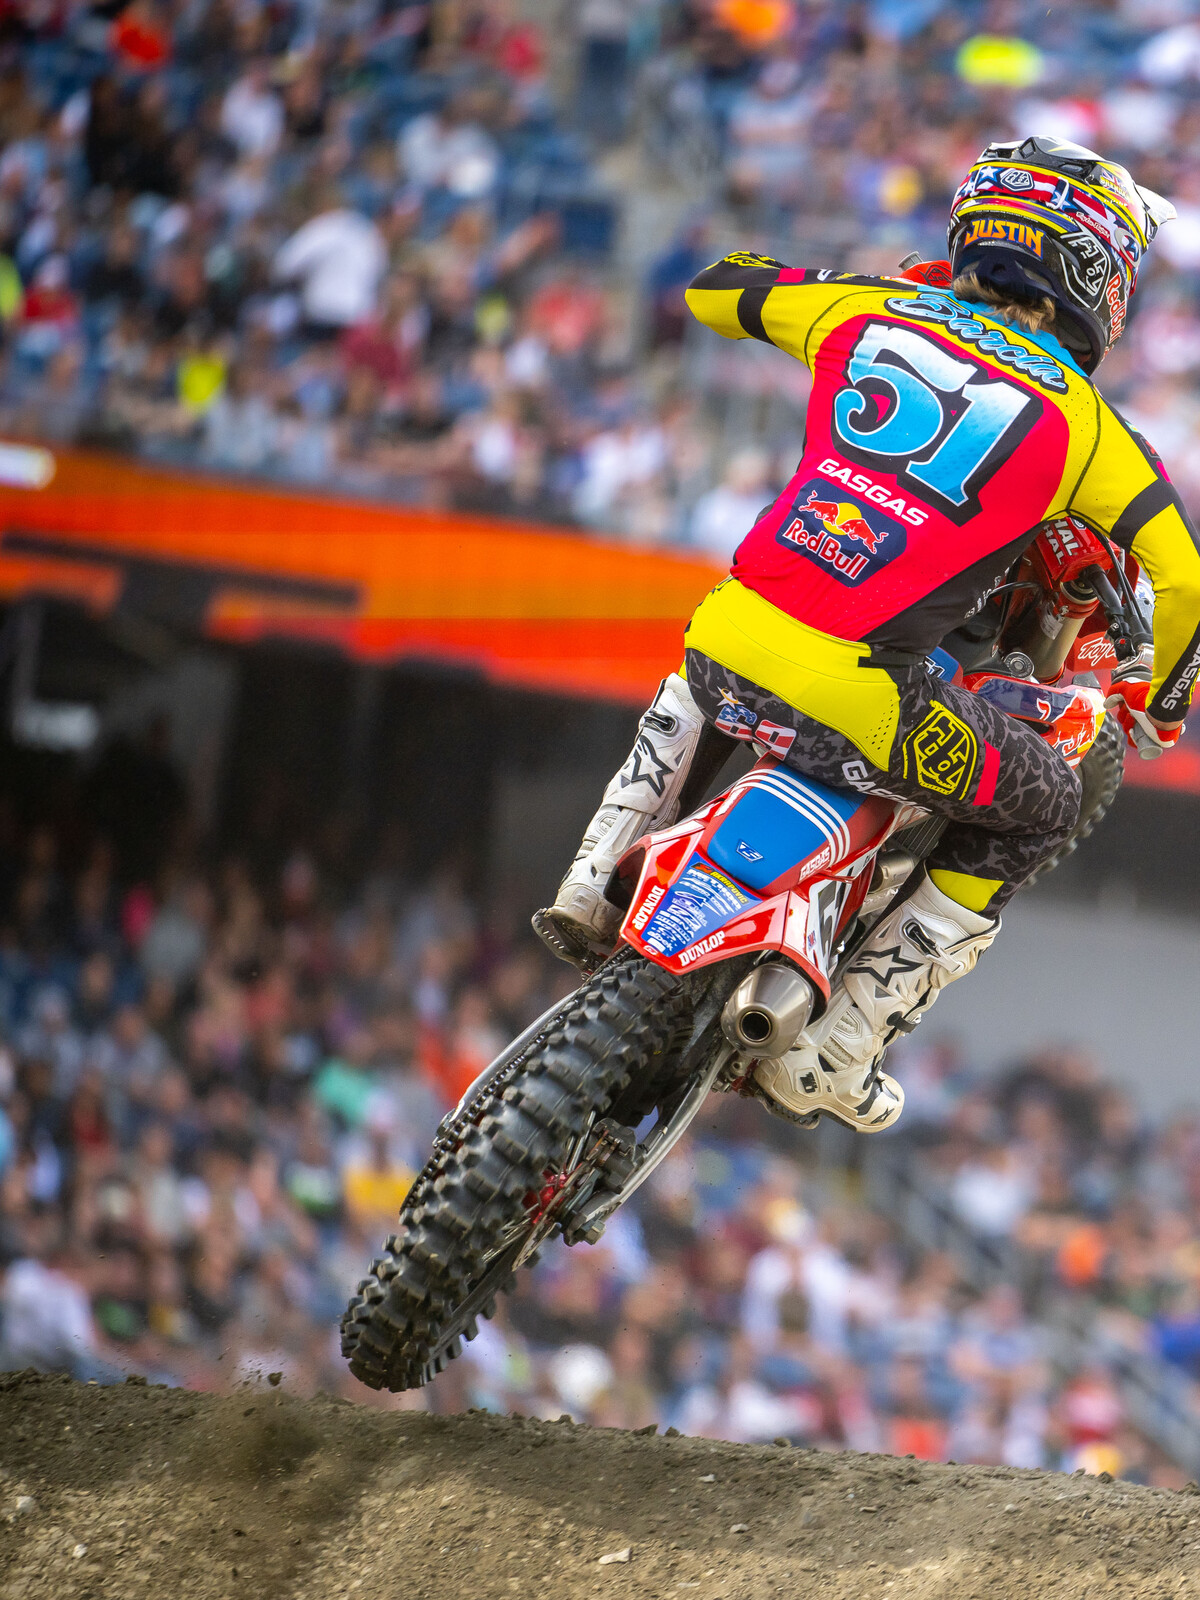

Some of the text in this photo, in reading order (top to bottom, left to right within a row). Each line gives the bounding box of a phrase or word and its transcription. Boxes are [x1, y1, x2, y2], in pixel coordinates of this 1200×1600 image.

[963, 218, 1045, 259] JUSTIN
[888, 293, 1066, 389] Barcia
[834, 323, 1031, 507] 51
[817, 458, 928, 526] GASGAS
[800, 846, 831, 880] GASGAS
[632, 885, 665, 930] DUNLOP
[678, 930, 726, 967] DUNLOP
